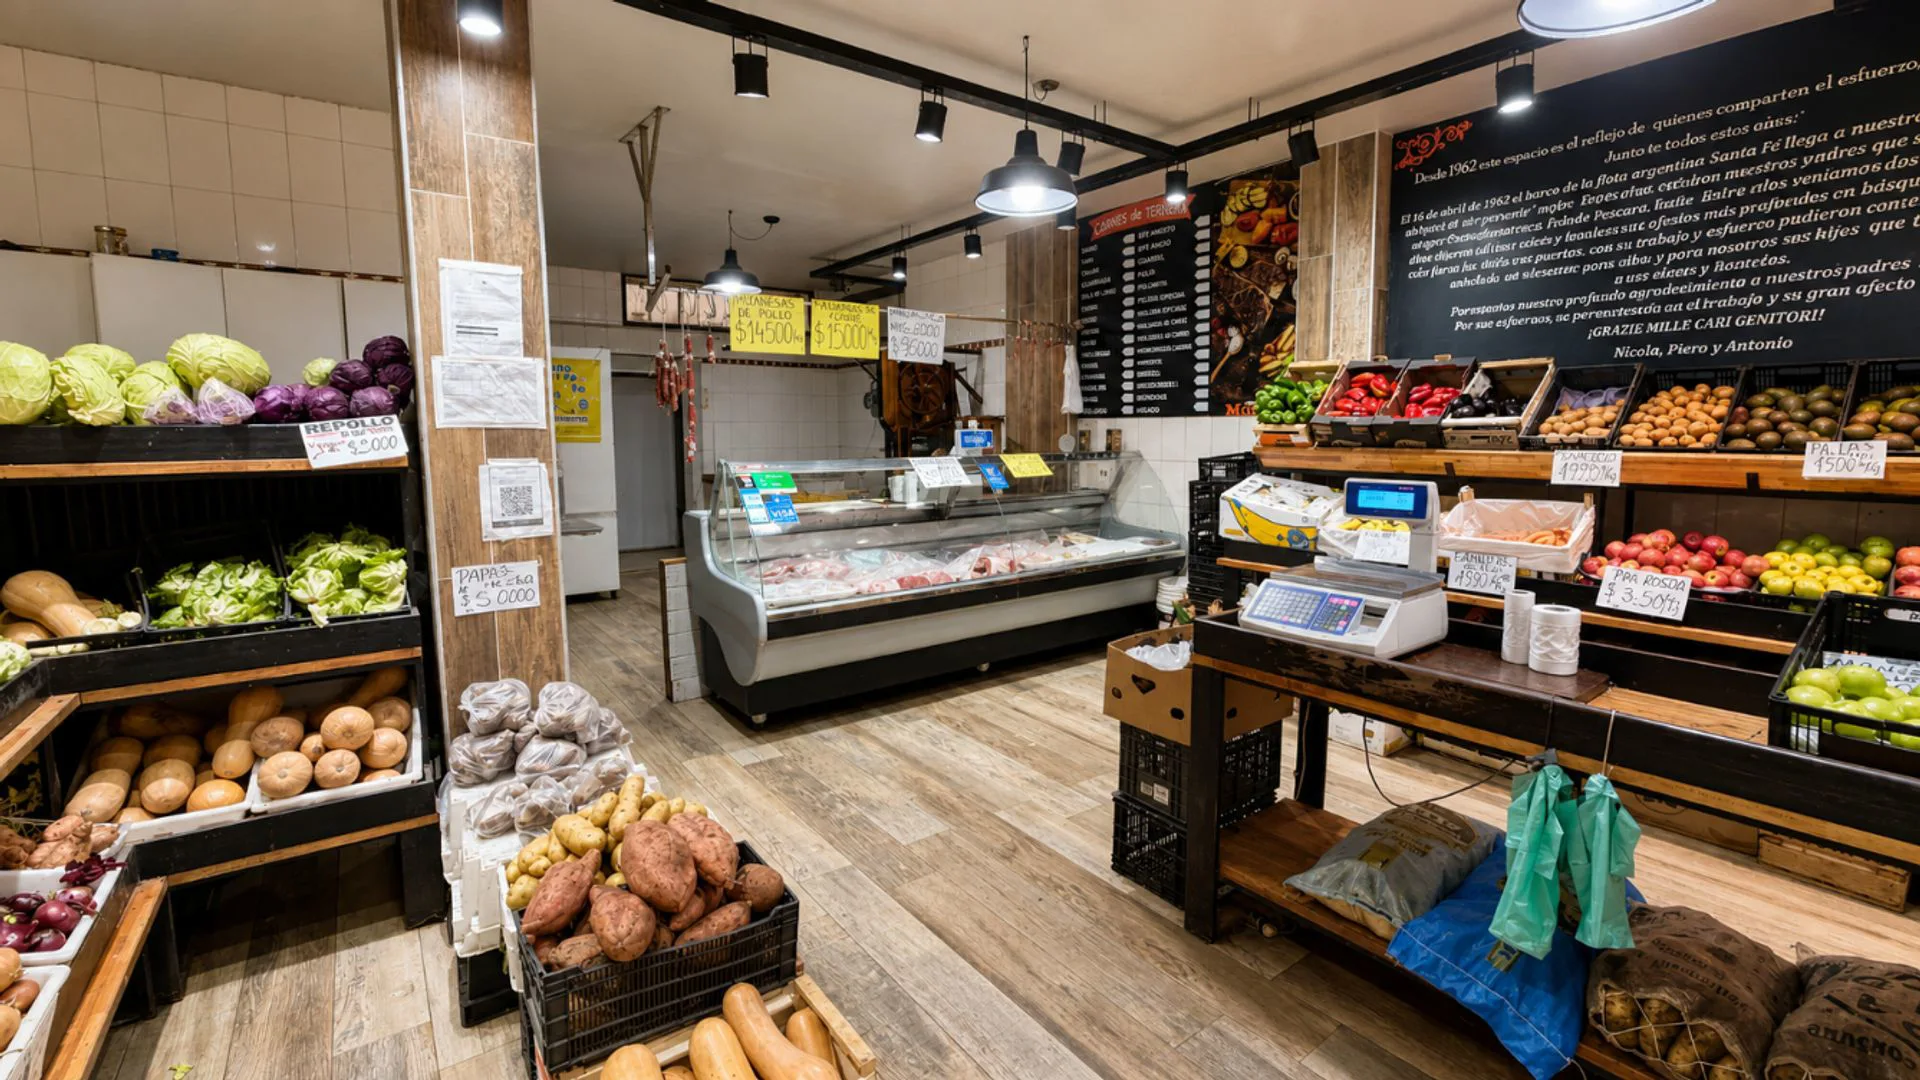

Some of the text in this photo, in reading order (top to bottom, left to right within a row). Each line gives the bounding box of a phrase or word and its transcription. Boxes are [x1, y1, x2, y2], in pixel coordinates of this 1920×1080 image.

[1415, 168, 1447, 184] Desde
[1449, 159, 1478, 177] 1962
[1479, 159, 1501, 170] este
[1503, 147, 1549, 165] espacio
[1551, 143, 1564, 153] es
[1581, 129, 1626, 146] reflejo
[1627, 121, 1646, 136] de
[1652, 108, 1713, 131] quienes
[1716, 86, 1810, 112] comparten
[1815, 73, 1833, 91] el
[1604, 149, 1646, 164] Junto
[1665, 133, 1707, 150] todos
[1710, 124, 1750, 141] estos
[1872, 136, 1909, 156] que
[1413, 211, 1425, 222] 16
[1426, 209, 1439, 220] de
[1441, 202, 1466, 217] abril
[1468, 200, 1482, 212] de
[1484, 194, 1511, 209] 1962
[1512, 191, 1523, 203] el
[1525, 187, 1560, 201] barco
[1563, 181, 1578, 193] de
[1581, 178, 1593, 190] la
[1595, 171, 1628, 189] flota
[1632, 158, 1705, 180] argentina
[1709, 145, 1757, 164] Santa
[1784, 132, 1829, 149] llega
[1833, 127, 1846, 140] a
[1636, 230, 1690, 248] trabajo
[1777, 208, 1862, 231] pudieron
[1707, 236, 1778, 256] nosotros
[1869, 218, 1906, 236] que
[1766, 266, 1842, 285] nuestros
[1843, 259, 1912, 280] padres
[1806, 286, 1851, 303] gran
[1856, 277, 1916, 297] afecto
[758, 308, 793, 320] POLLO
[1588, 308, 1826, 340] ¡GRAZIE MILLE CARI GENITORI!
[1614, 336, 1793, 359] Nicola, Piero y Antonio
[304, 416, 394, 435] REPOLLO
